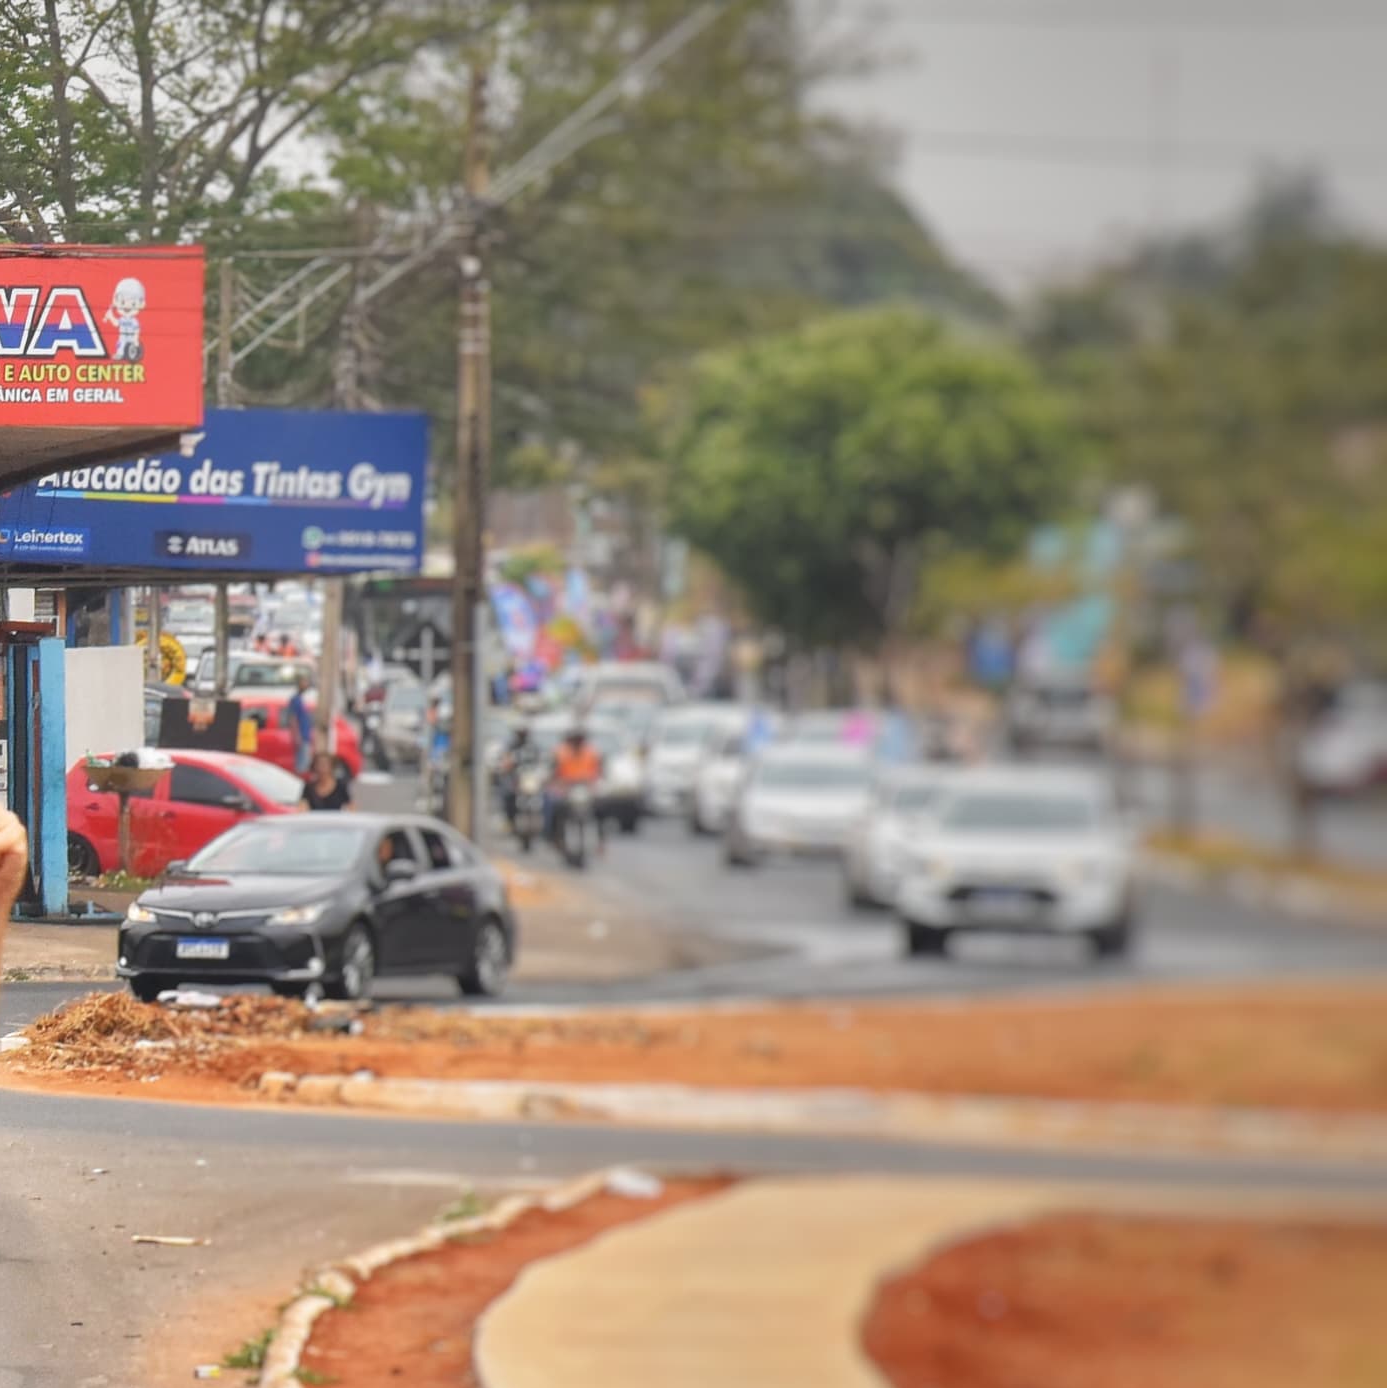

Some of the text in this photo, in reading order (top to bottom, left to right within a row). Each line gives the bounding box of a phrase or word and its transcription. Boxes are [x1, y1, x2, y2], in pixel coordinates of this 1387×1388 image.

[4, 364, 15, 382] E
[19, 363, 72, 383] AUTO
[75, 363, 146, 383] CENTER
[46, 388, 69, 403] EM
[73, 388, 124, 403] GERAL
[189, 458, 245, 496] das
[251, 461, 343, 500] Tintas
